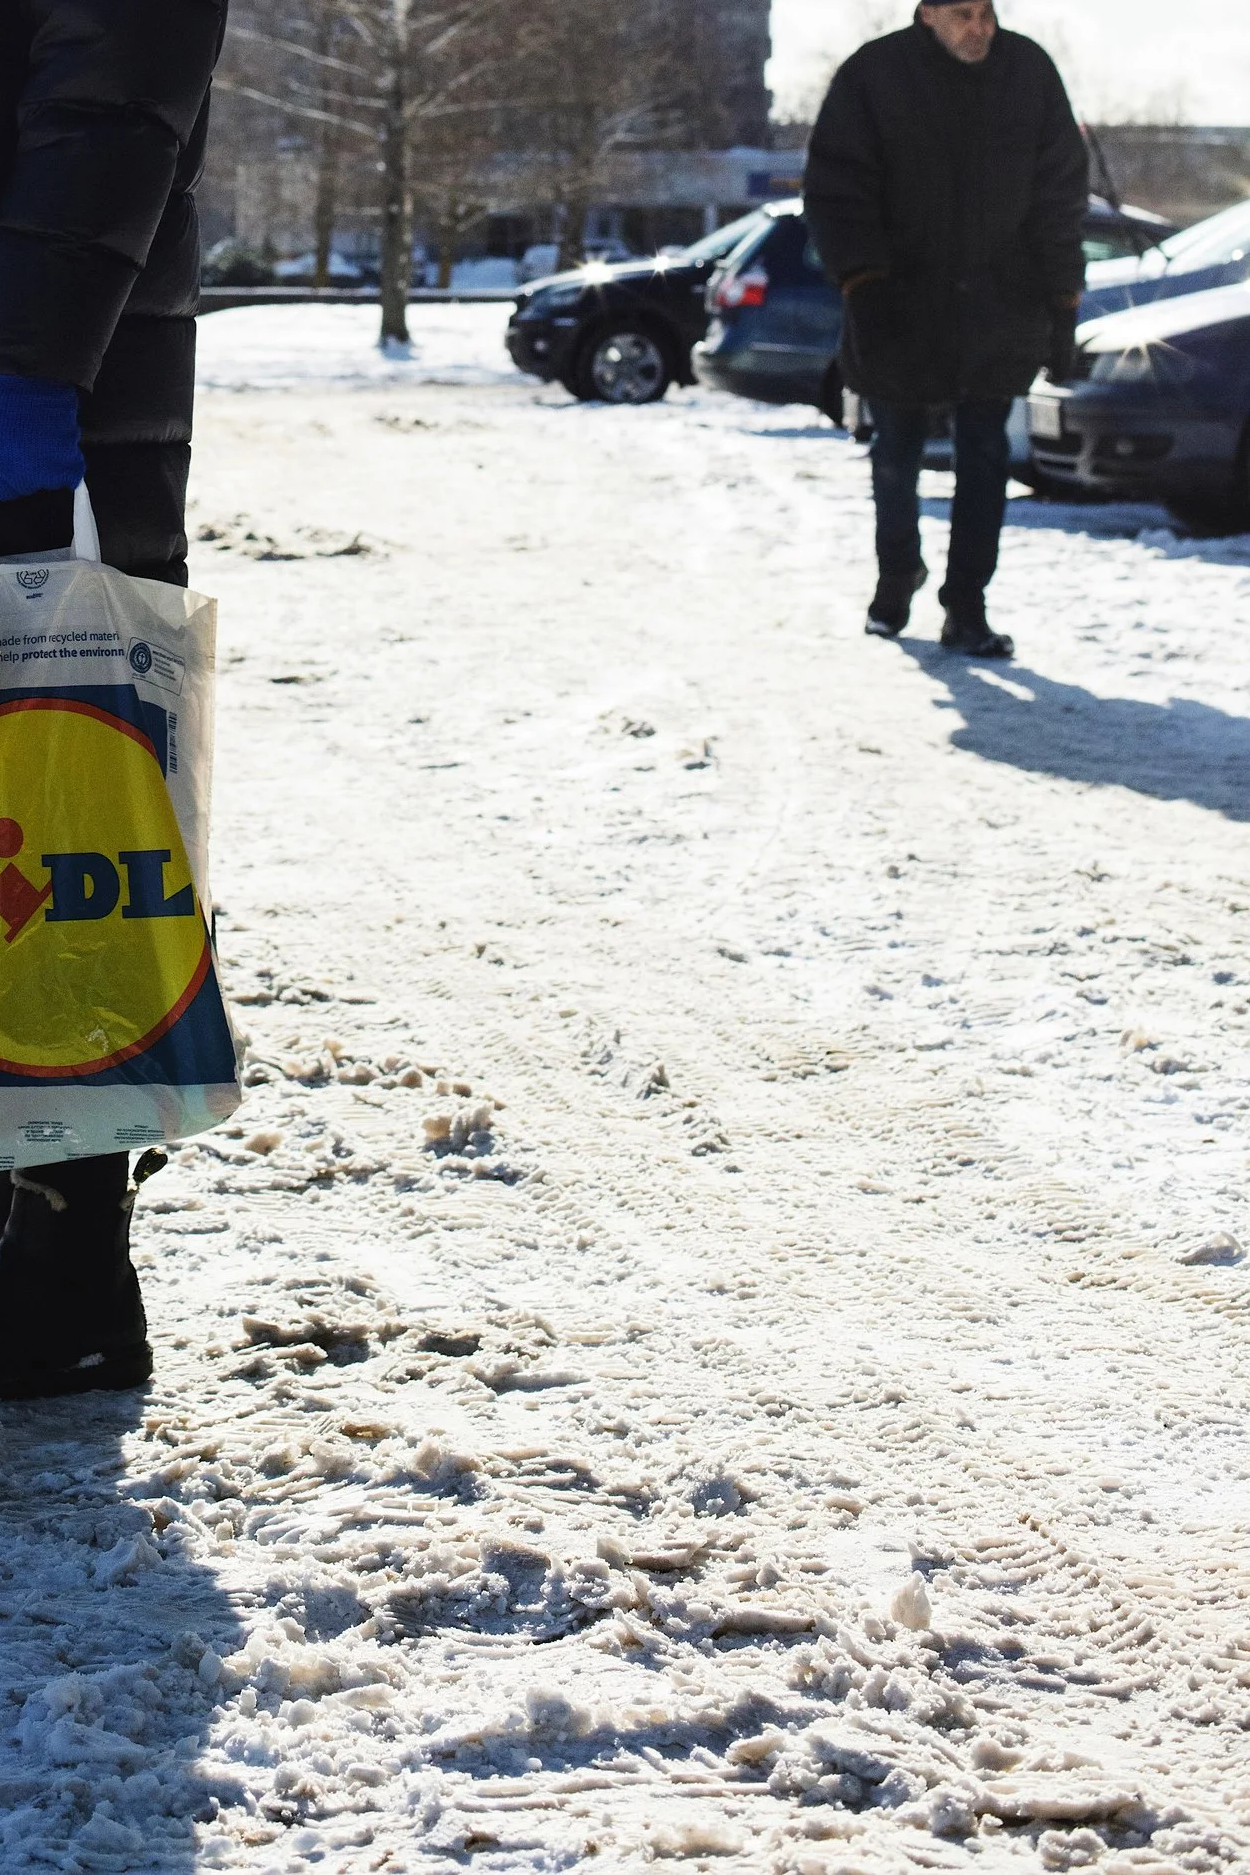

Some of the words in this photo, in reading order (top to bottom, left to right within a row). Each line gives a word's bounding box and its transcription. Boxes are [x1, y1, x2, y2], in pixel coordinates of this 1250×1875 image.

[23, 634, 47, 645] from
[49, 631, 87, 645] recycled
[21, 649, 57, 663] protect
[59, 647, 78, 659] the
